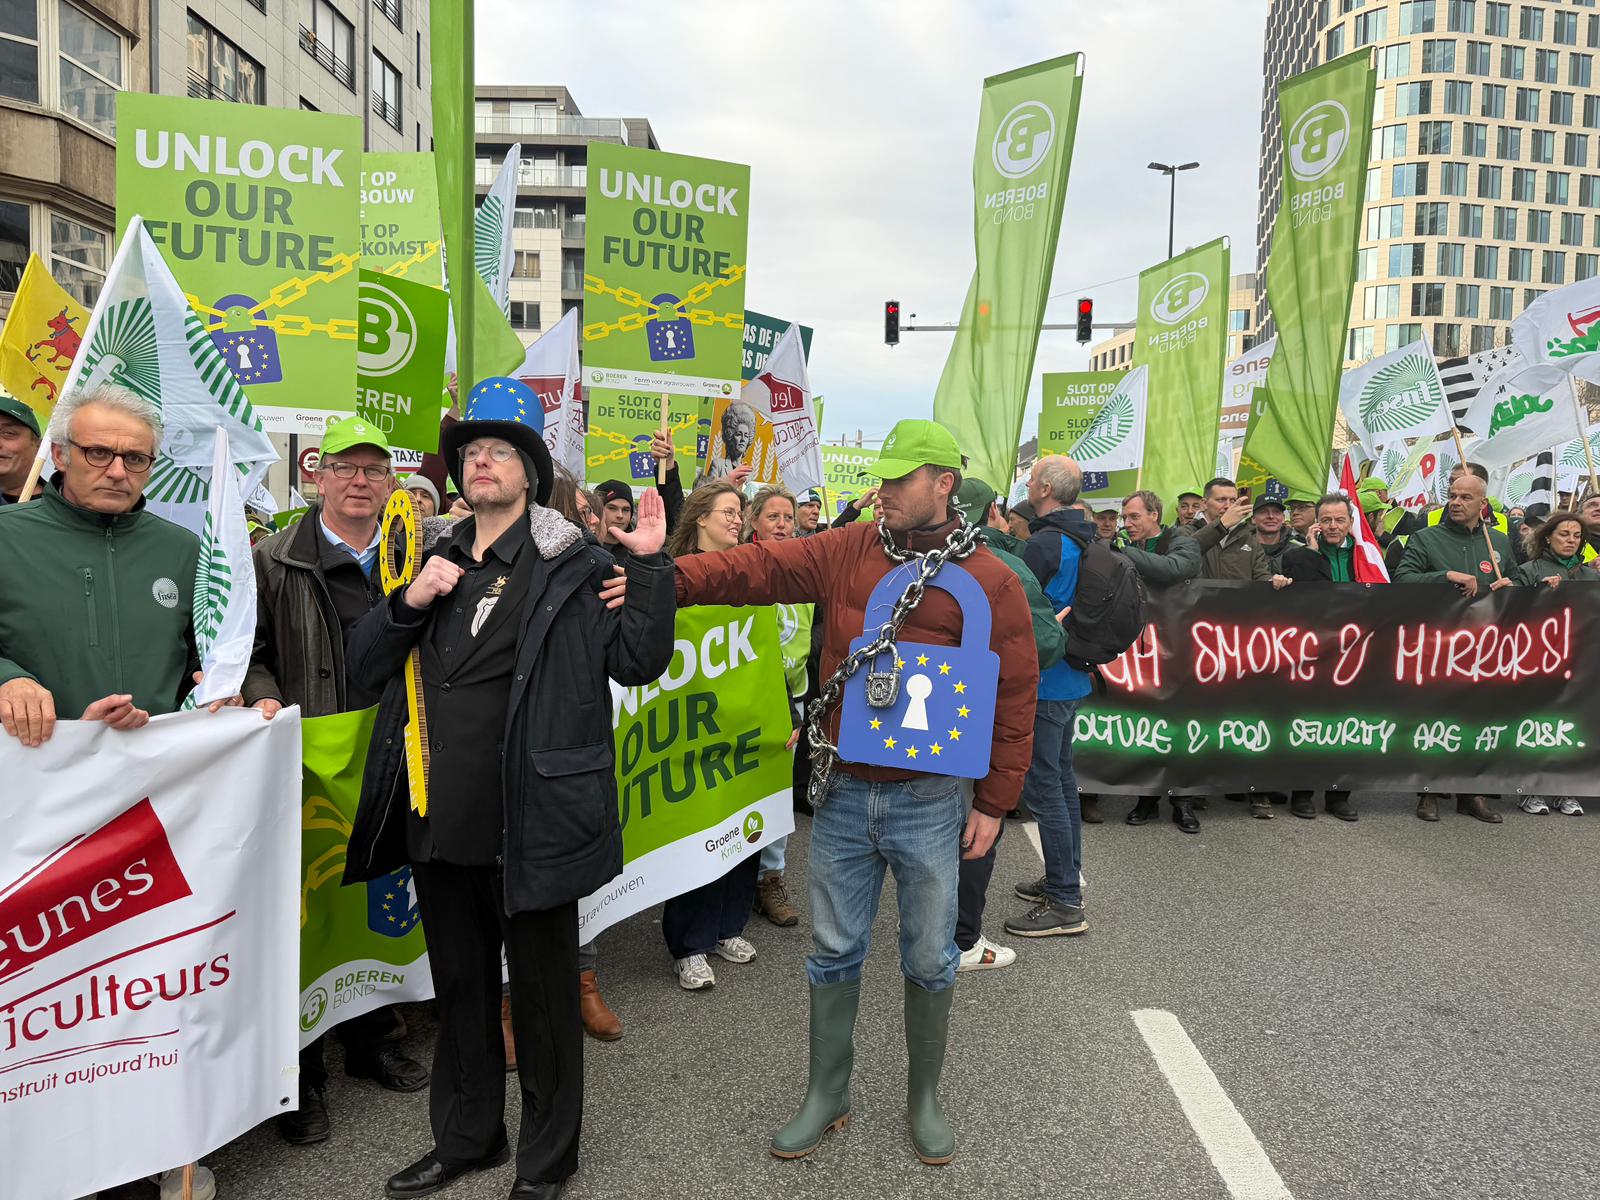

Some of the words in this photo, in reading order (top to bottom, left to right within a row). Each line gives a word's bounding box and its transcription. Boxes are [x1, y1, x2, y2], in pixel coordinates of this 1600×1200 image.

[134, 128, 345, 187] UNLOCK
[371, 171, 397, 187] OP
[599, 167, 739, 216] UNLOCK
[184, 179, 294, 226] OUR
[360, 188, 415, 205] BOUW
[374, 223, 399, 239] OP
[632, 207, 705, 244] OUR
[143, 220, 335, 274] FUTURE
[362, 240, 428, 256] KOMST
[602, 235, 732, 280] FUTURE
[743, 323, 757, 344] AS
[758, 327, 773, 348] DE
[618, 394, 650, 407] SLOT
[1067, 384, 1096, 394] SLOT
[1098, 383, 1115, 393] OP
[356, 388, 413, 416] EREN
[598, 405, 615, 418] DE
[295, 414, 323, 423] Groene
[304, 422, 323, 431] Kring
[1049, 430, 1065, 441] DE
[393, 449, 423, 463] TAXE
[1191, 620, 1318, 681] SMOKE
[1396, 607, 1572, 686] MIRRORS!
[621, 690, 721, 777] OUR
[1219, 719, 1271, 752] FOOD
[1413, 720, 1462, 753] ARE
[1475, 724, 1507, 752] AT
[704, 825, 740, 853] Groene
[720, 840, 742, 861] Kring
[578, 875, 645, 930] gravrouwen
[335, 970, 405, 994] BOEREN
[4, 952, 231, 1051] iculteurs
[333, 984, 377, 1010] BOND
[0, 1073, 58, 1104] nstruit
[64, 1048, 180, 1086] aujourd'hui
